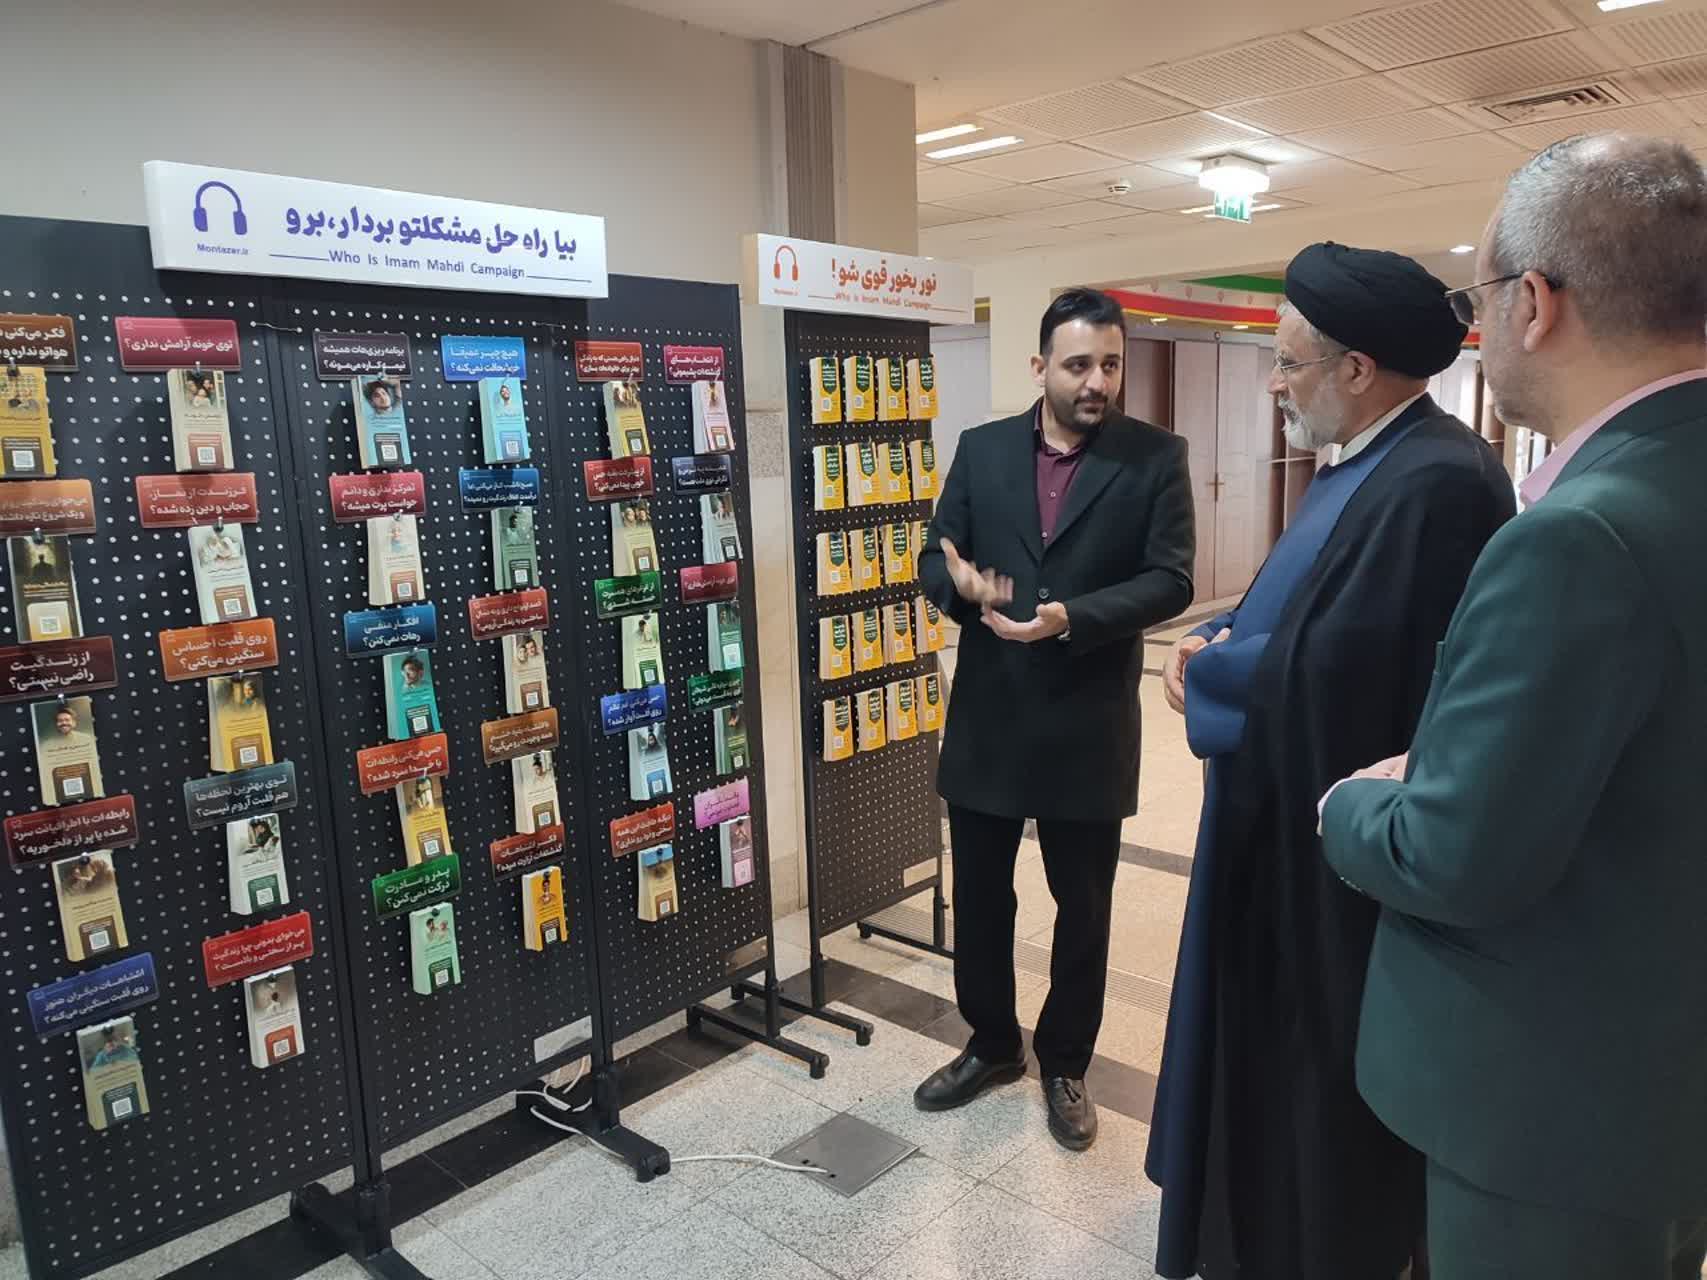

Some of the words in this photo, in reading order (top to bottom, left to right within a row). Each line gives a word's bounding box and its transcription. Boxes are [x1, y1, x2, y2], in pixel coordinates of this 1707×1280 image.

[399, 214, 482, 246] مشکلتو
[486, 223, 518, 254] حل
[522, 227, 548, 257] راه
[553, 229, 577, 260] بیا
[329, 249, 361, 264] Who
[367, 253, 379, 266] Is
[384, 254, 420, 269] Imam
[426, 258, 465, 273] Mahdi
[470, 262, 526, 280] Campaign
[861, 259, 888, 291] قوی
[888, 267, 917, 296] بخور
[918, 272, 937, 296] نور
[44, 326, 66, 341] فکر
[160, 335, 192, 352] آرامش
[192, 340, 215, 350] خونه
[216, 340, 233, 351] توی
[323, 345, 350, 355] همیشه
[11, 346, 36, 359] نداره
[39, 347, 69, 360] هواتو
[368, 486, 387, 498] نداری
[387, 484, 416, 496] تمرکز
[196, 503, 215, 516] دین
[222, 502, 250, 512] حجاب
[372, 501, 388, 512] پرت
[388, 498, 417, 509] حواست
[363, 620, 395, 634] منفی
[395, 616, 420, 631] افکار
[218, 632, 245, 649] قلبت
[246, 634, 267, 646] روی
[401, 632, 421, 642] رهات
[173, 639, 217, 656] احساس
[10, 653, 79, 671] زندگیت
[81, 651, 91, 666] از
[226, 650, 264, 666] سنگینی
[60, 668, 94, 685] راضی
[236, 780, 265, 796] بهترین
[266, 775, 288, 790] توی
[252, 792, 274, 808] قلبت
[274, 791, 289, 804] هم
[83, 815, 92, 826] با
[13, 827, 35, 841] سرد
[102, 824, 127, 836] شده
